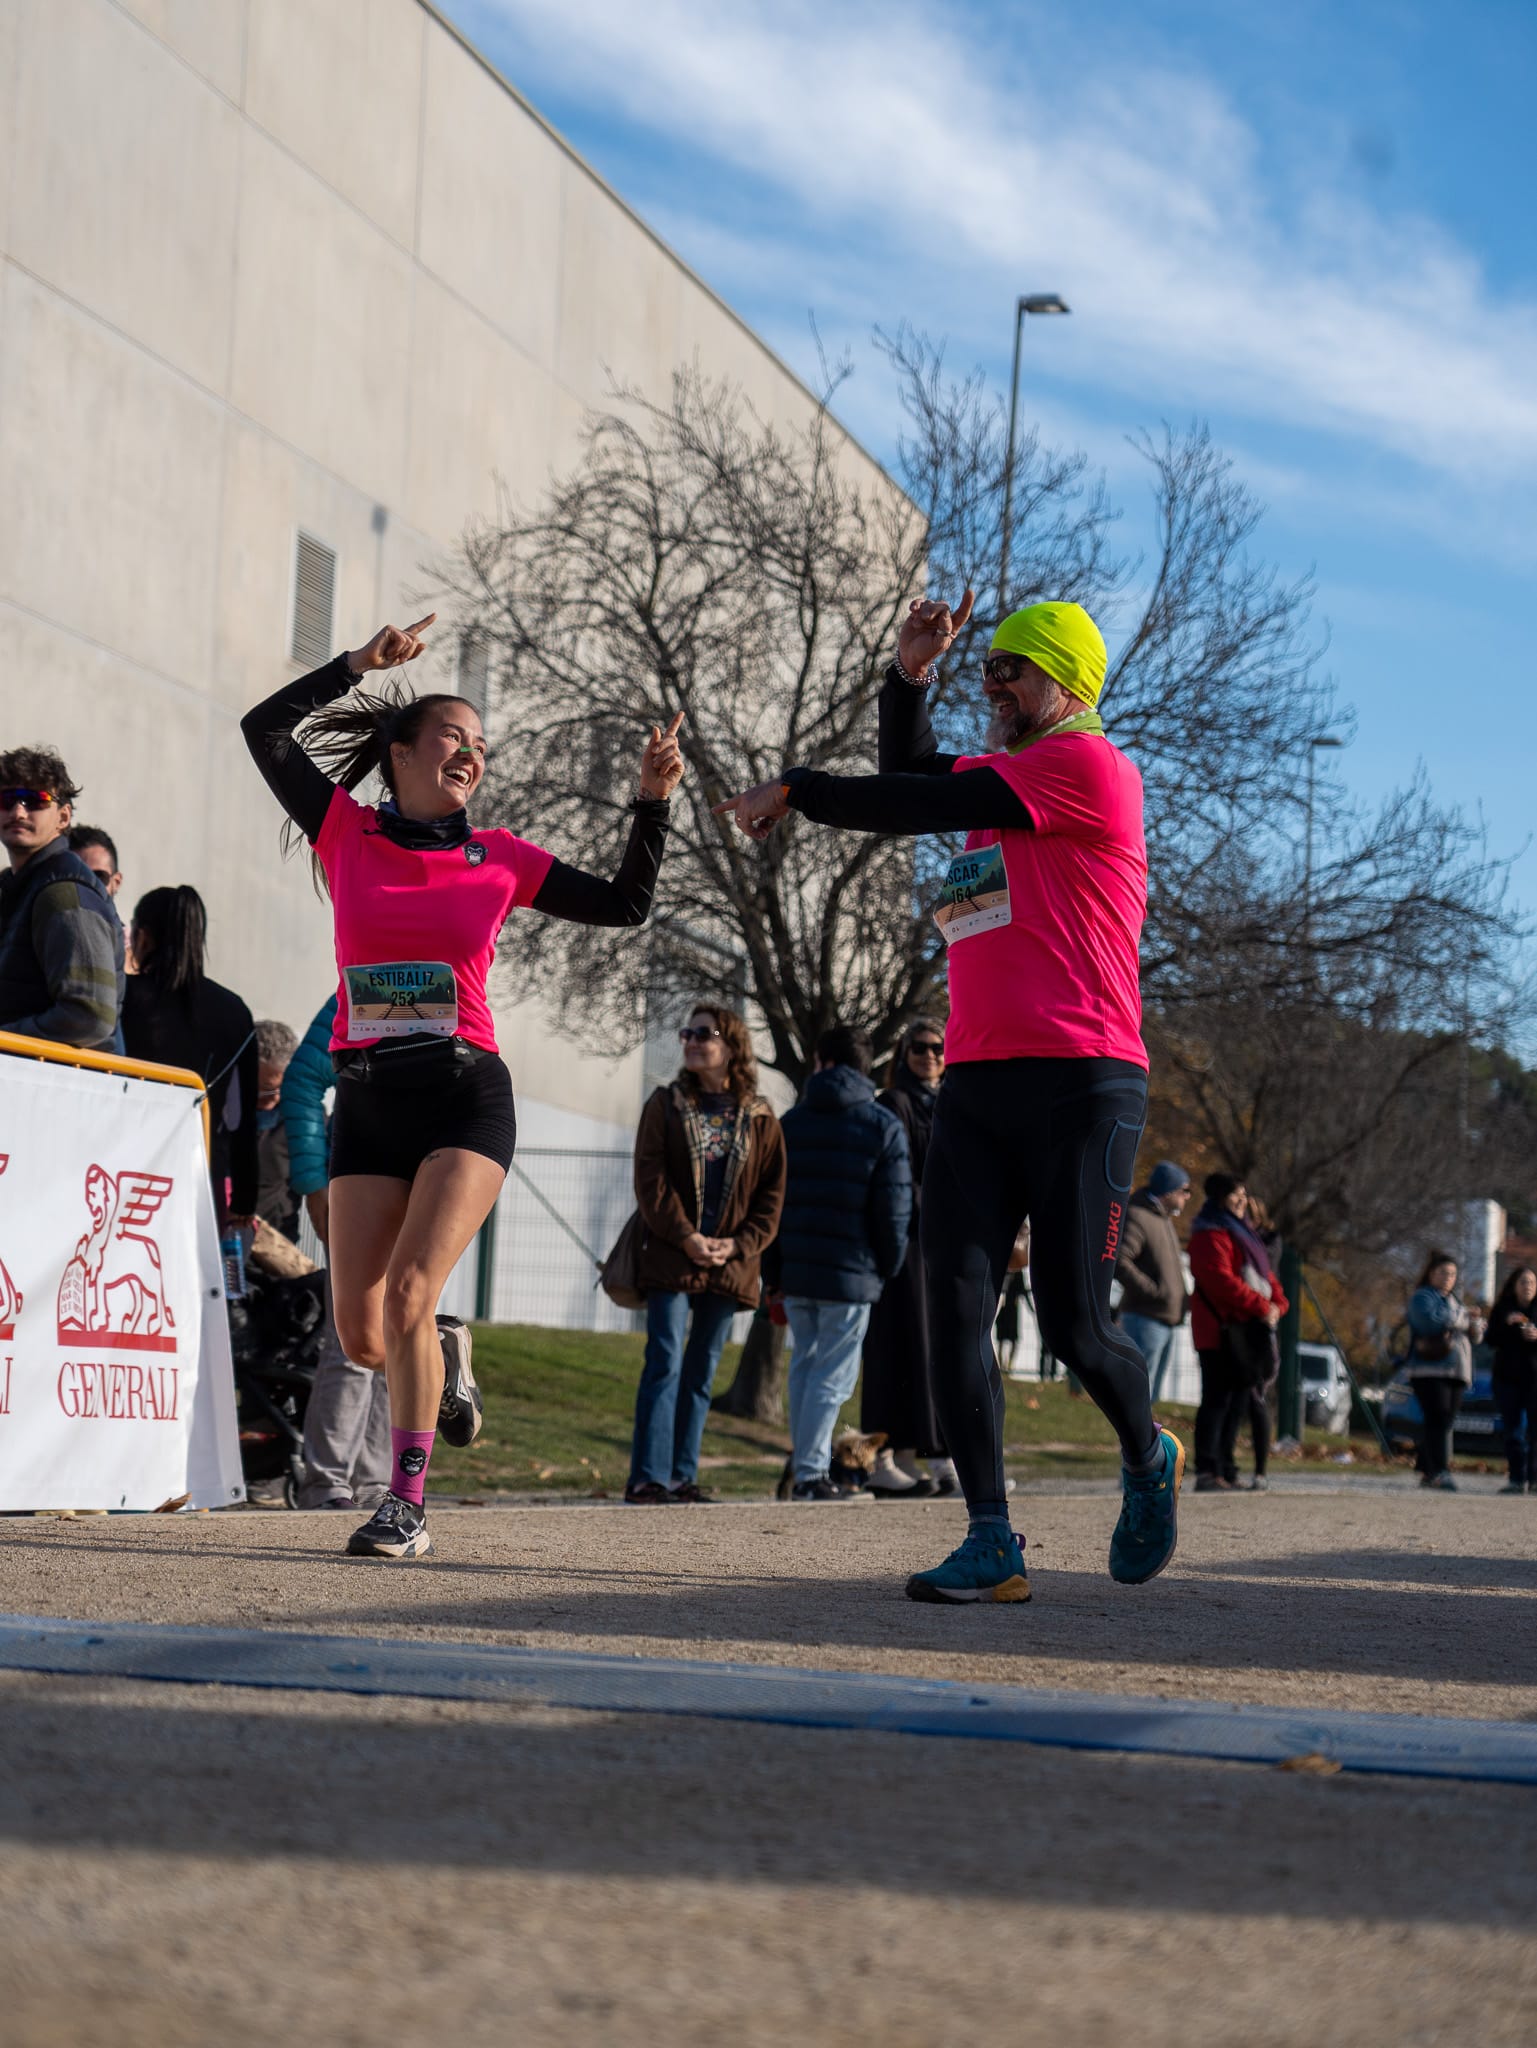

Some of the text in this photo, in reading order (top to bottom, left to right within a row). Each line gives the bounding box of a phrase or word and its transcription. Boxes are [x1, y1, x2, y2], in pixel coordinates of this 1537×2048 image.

[369, 971, 435, 987] ESTIBALIZ
[391, 991, 415, 1007] 253
[57, 1361, 178, 1421] GENERALI
